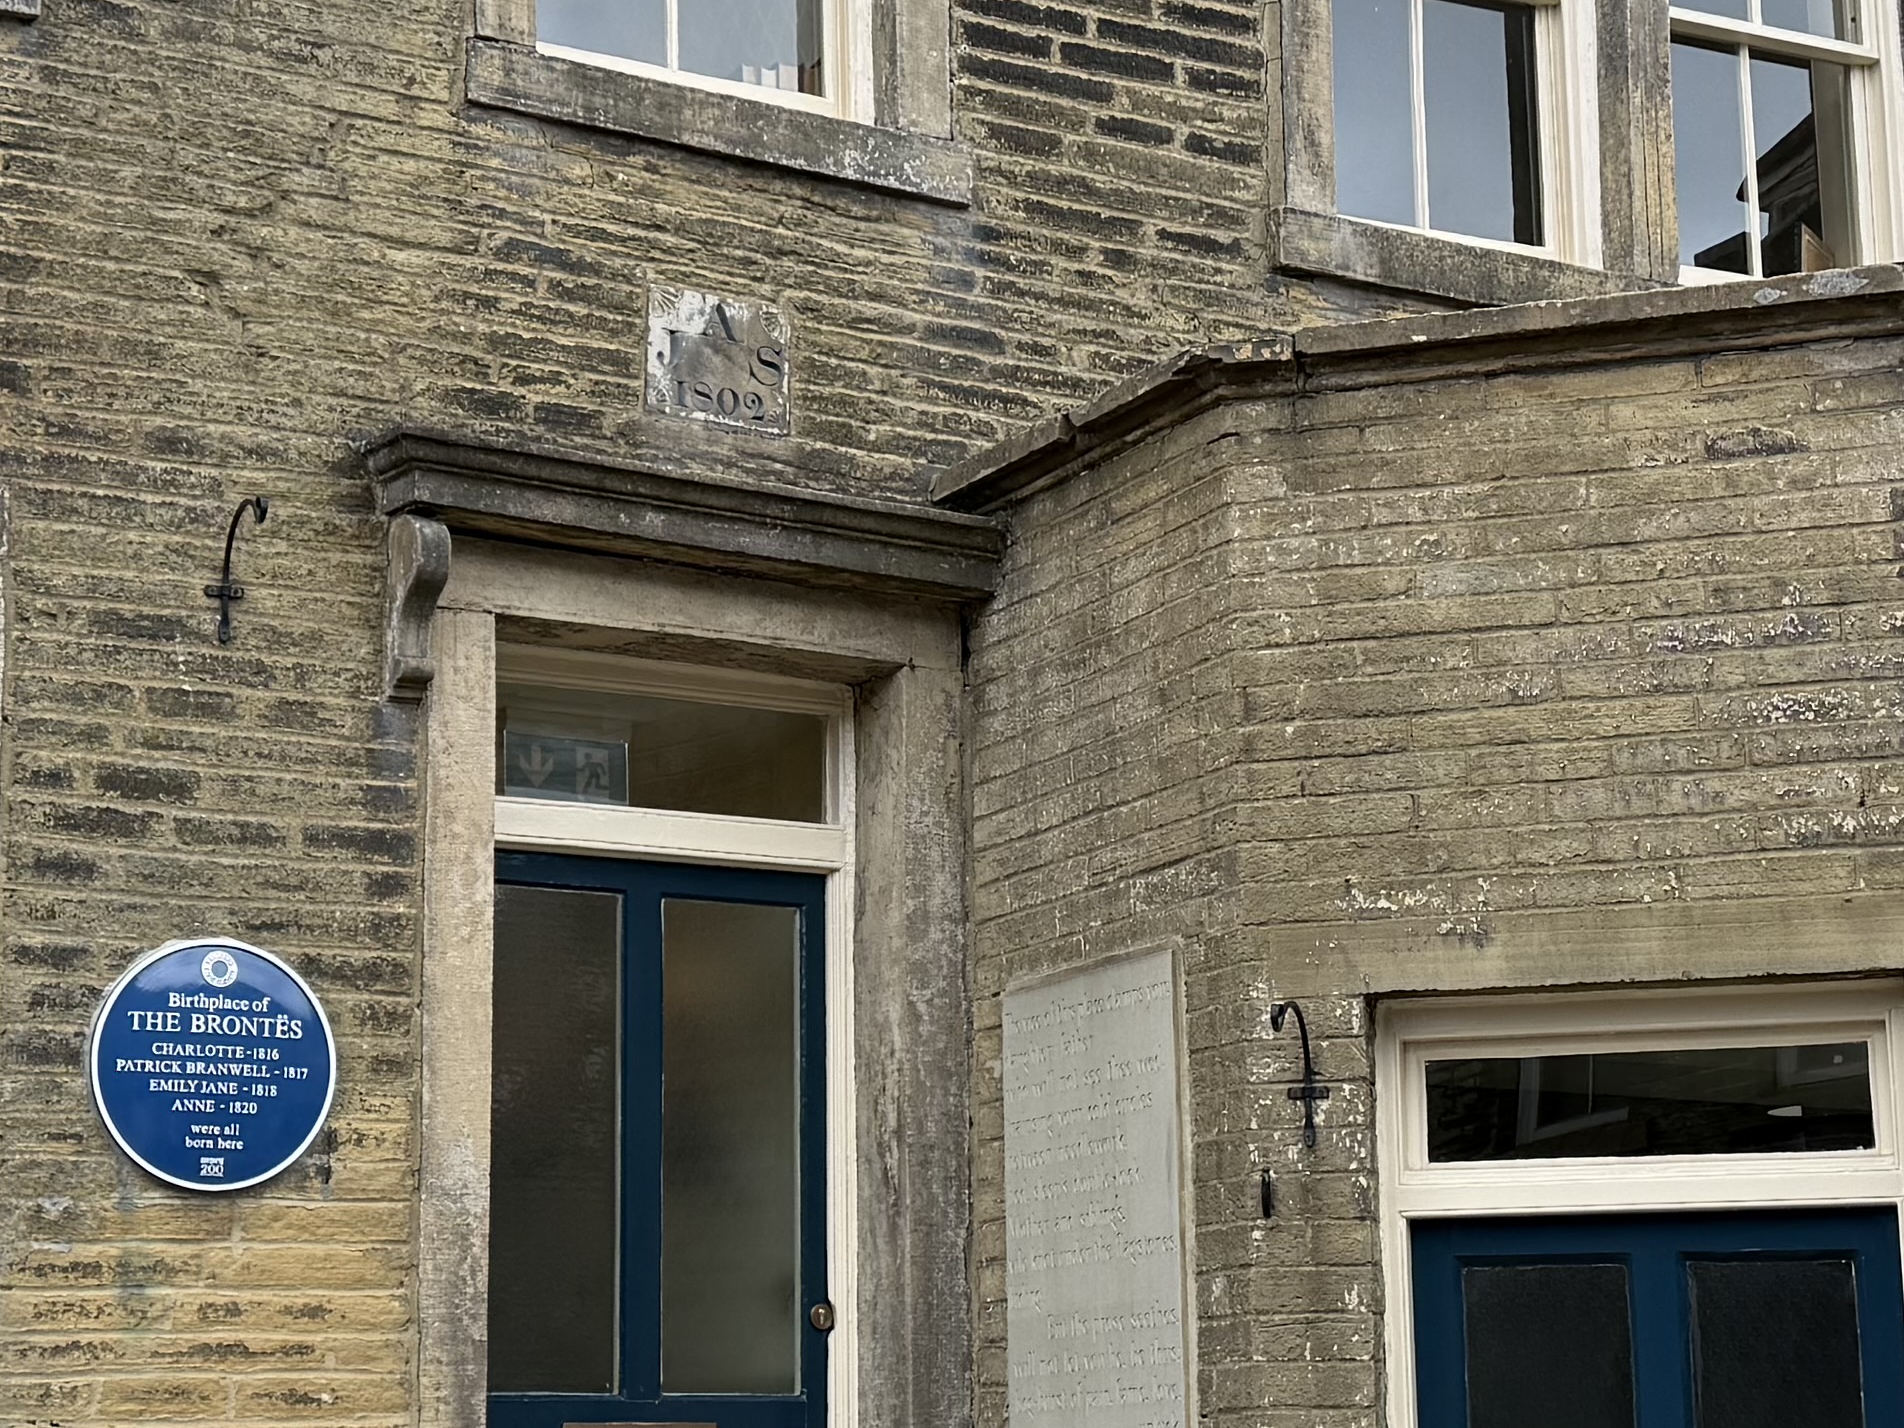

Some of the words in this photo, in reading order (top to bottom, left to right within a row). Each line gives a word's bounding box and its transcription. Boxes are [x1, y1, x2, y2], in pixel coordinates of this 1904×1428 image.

[748, 345, 783, 387] S
[673, 380, 765, 421] 1802
[168, 992, 249, 1012] Birthplace
[252, 996, 271, 1012] of
[127, 1011, 181, 1032] THE
[190, 1013, 303, 1039] BRONTËS
[152, 1042, 245, 1059] CHARLOTTE
[116, 1058, 183, 1074] PATRICK
[186, 1061, 271, 1078] BRANWELL
[283, 1067, 308, 1079] 1817
[149, 1079, 198, 1093] EMILY
[200, 1081, 238, 1095] JANE
[251, 1084, 278, 1097] 1818
[171, 1099, 216, 1113] ANNE
[229, 1101, 258, 1114] 1820
[191, 1124, 221, 1135] were
[224, 1123, 240, 1136] all
[185, 1136, 214, 1149] born
[218, 1137, 244, 1150] here
